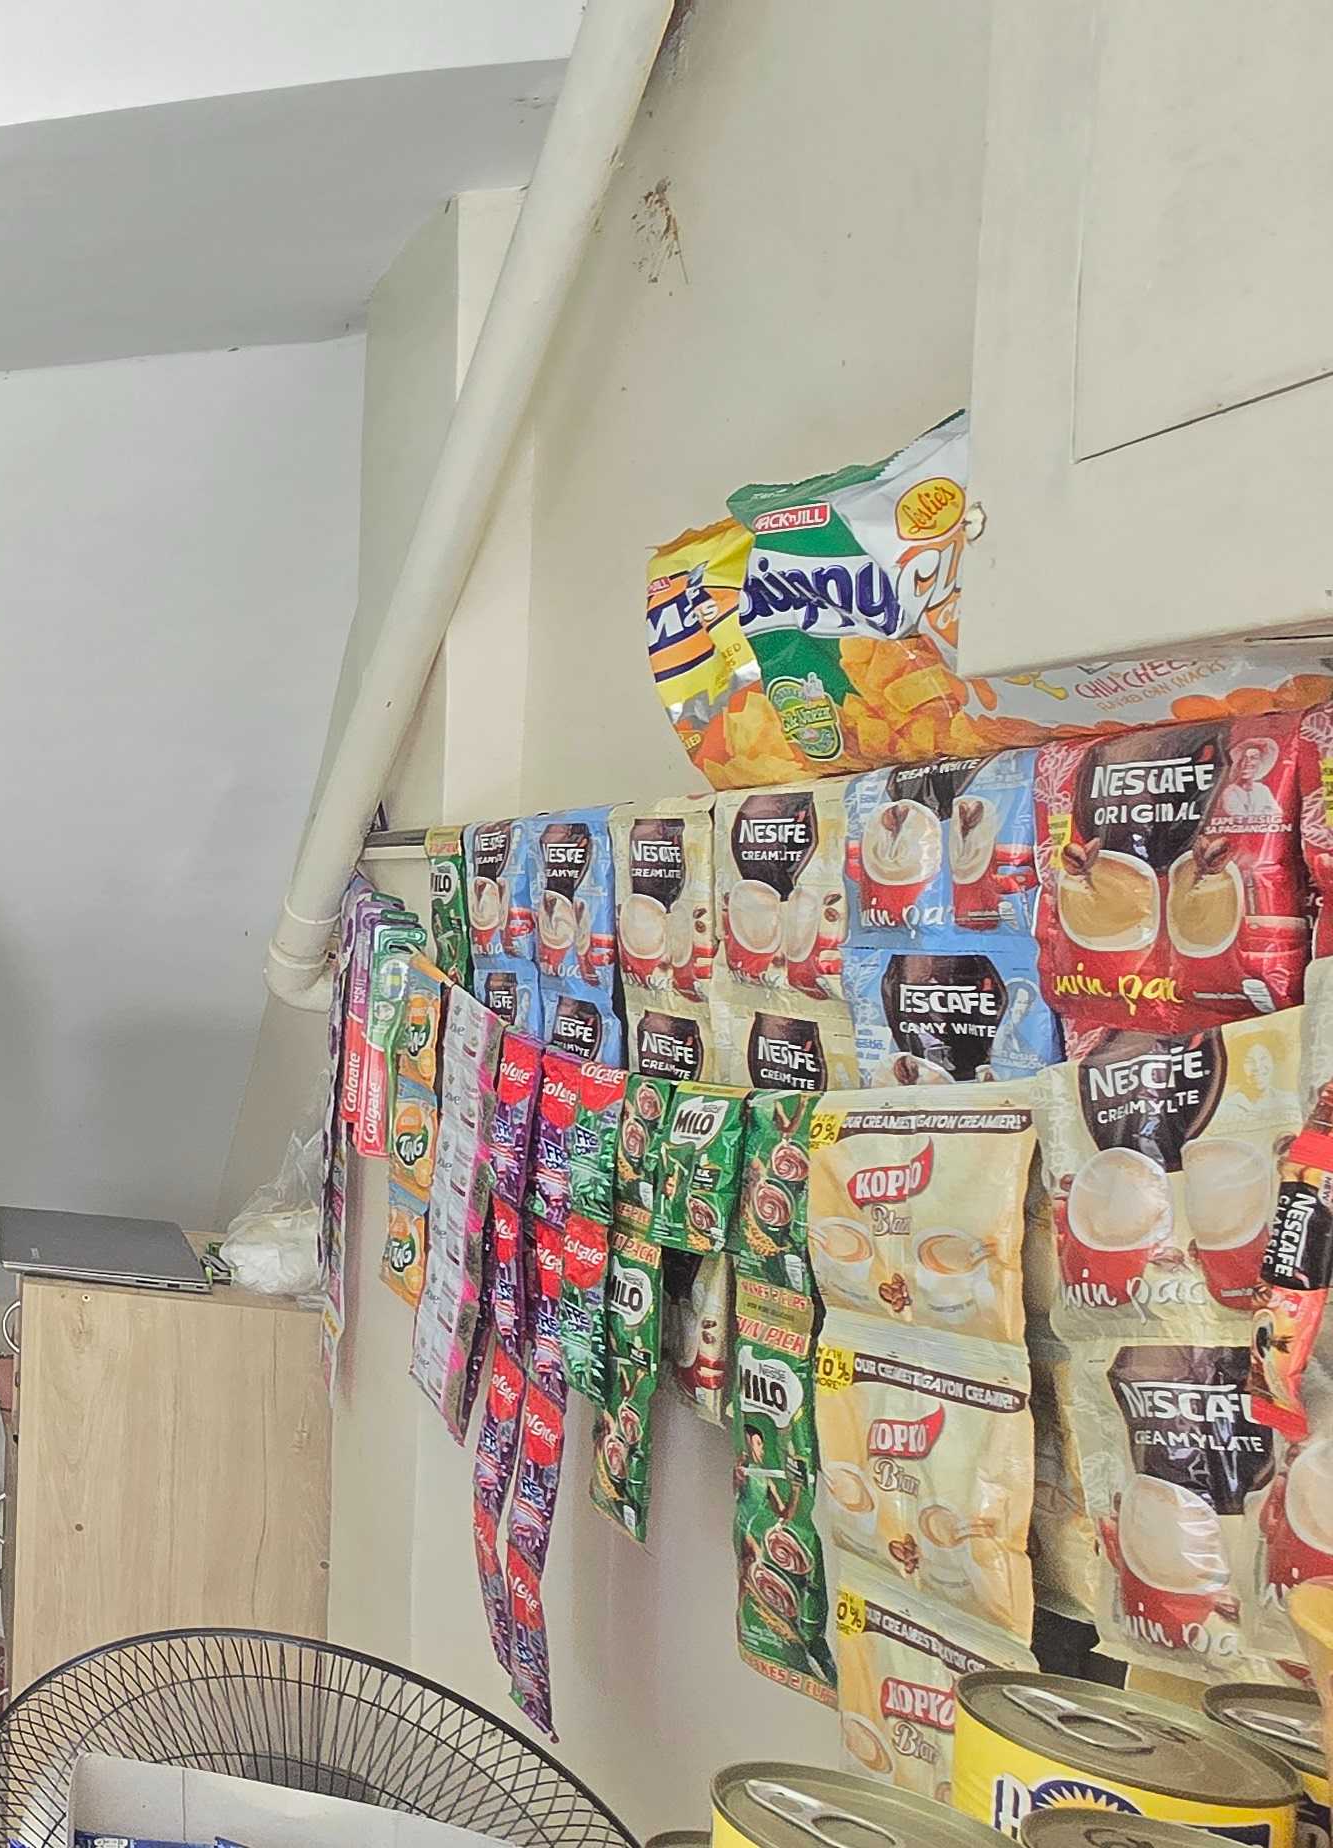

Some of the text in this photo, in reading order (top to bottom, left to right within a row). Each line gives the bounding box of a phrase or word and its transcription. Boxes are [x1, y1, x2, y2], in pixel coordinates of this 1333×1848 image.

[432, 871, 452, 891] ILO
[899, 984, 997, 1017] ESCAFE
[363, 1081, 381, 1144] Colgate
[673, 1109, 714, 1136] MILO
